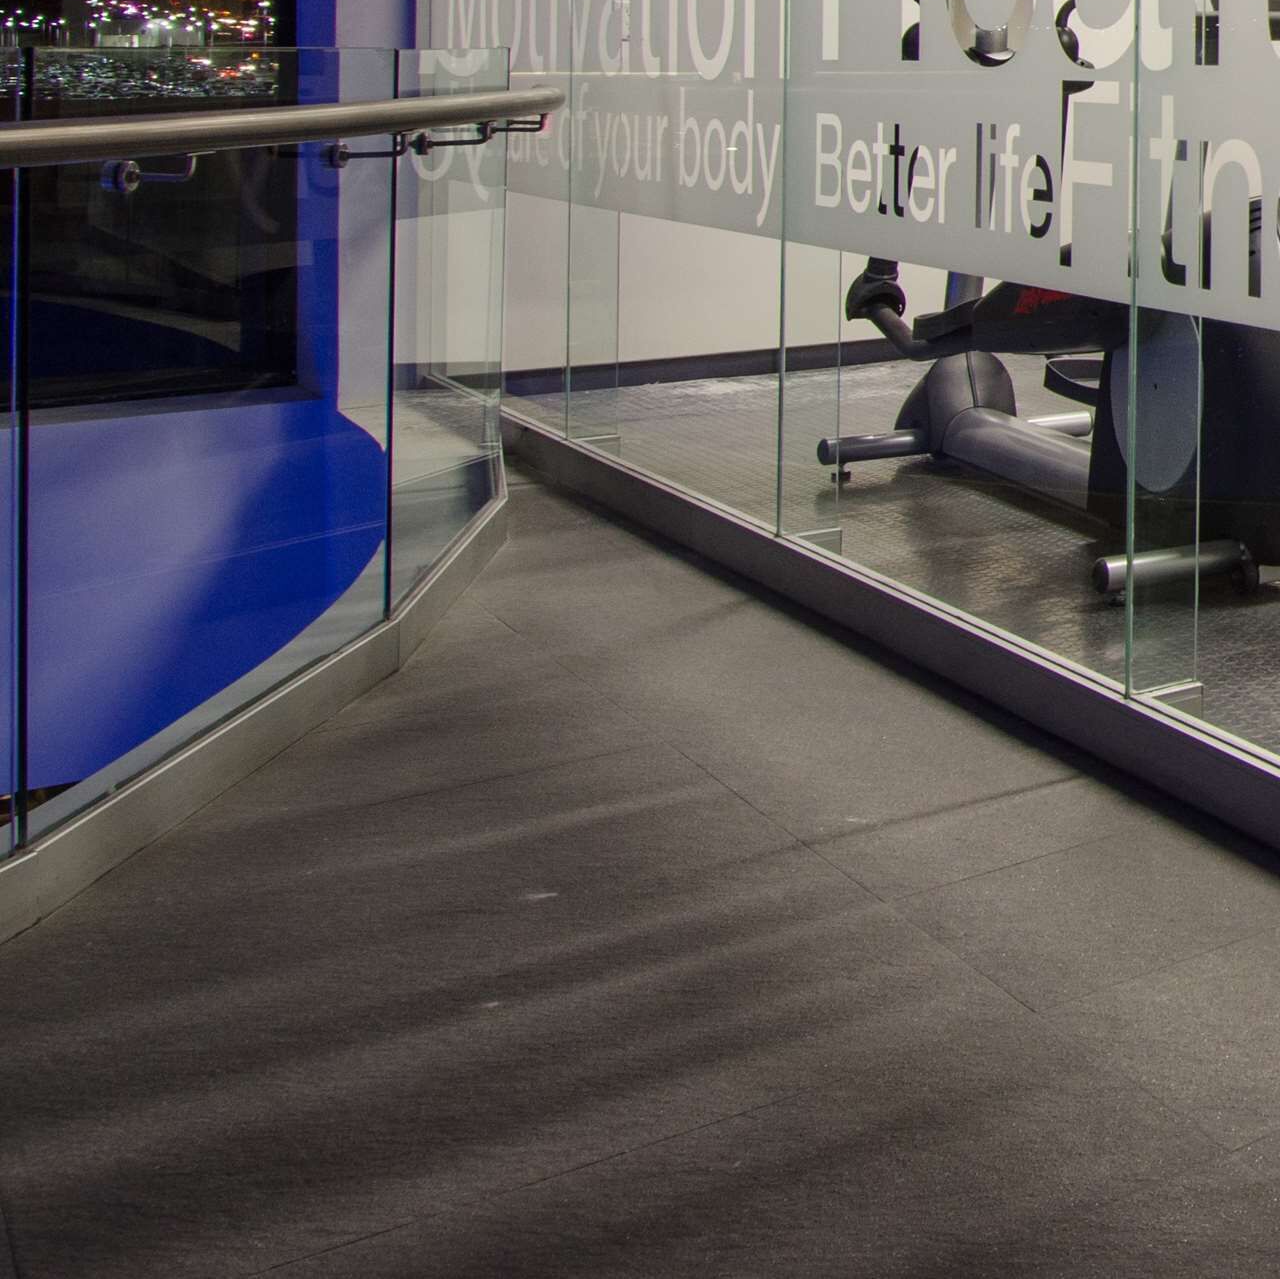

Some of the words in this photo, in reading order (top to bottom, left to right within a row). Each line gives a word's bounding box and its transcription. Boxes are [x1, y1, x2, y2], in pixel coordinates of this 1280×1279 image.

[558, 82, 590, 172] of
[591, 111, 669, 200] your
[679, 86, 781, 228] body
[815, 110, 957, 225] Better
[974, 121, 1054, 241] life
